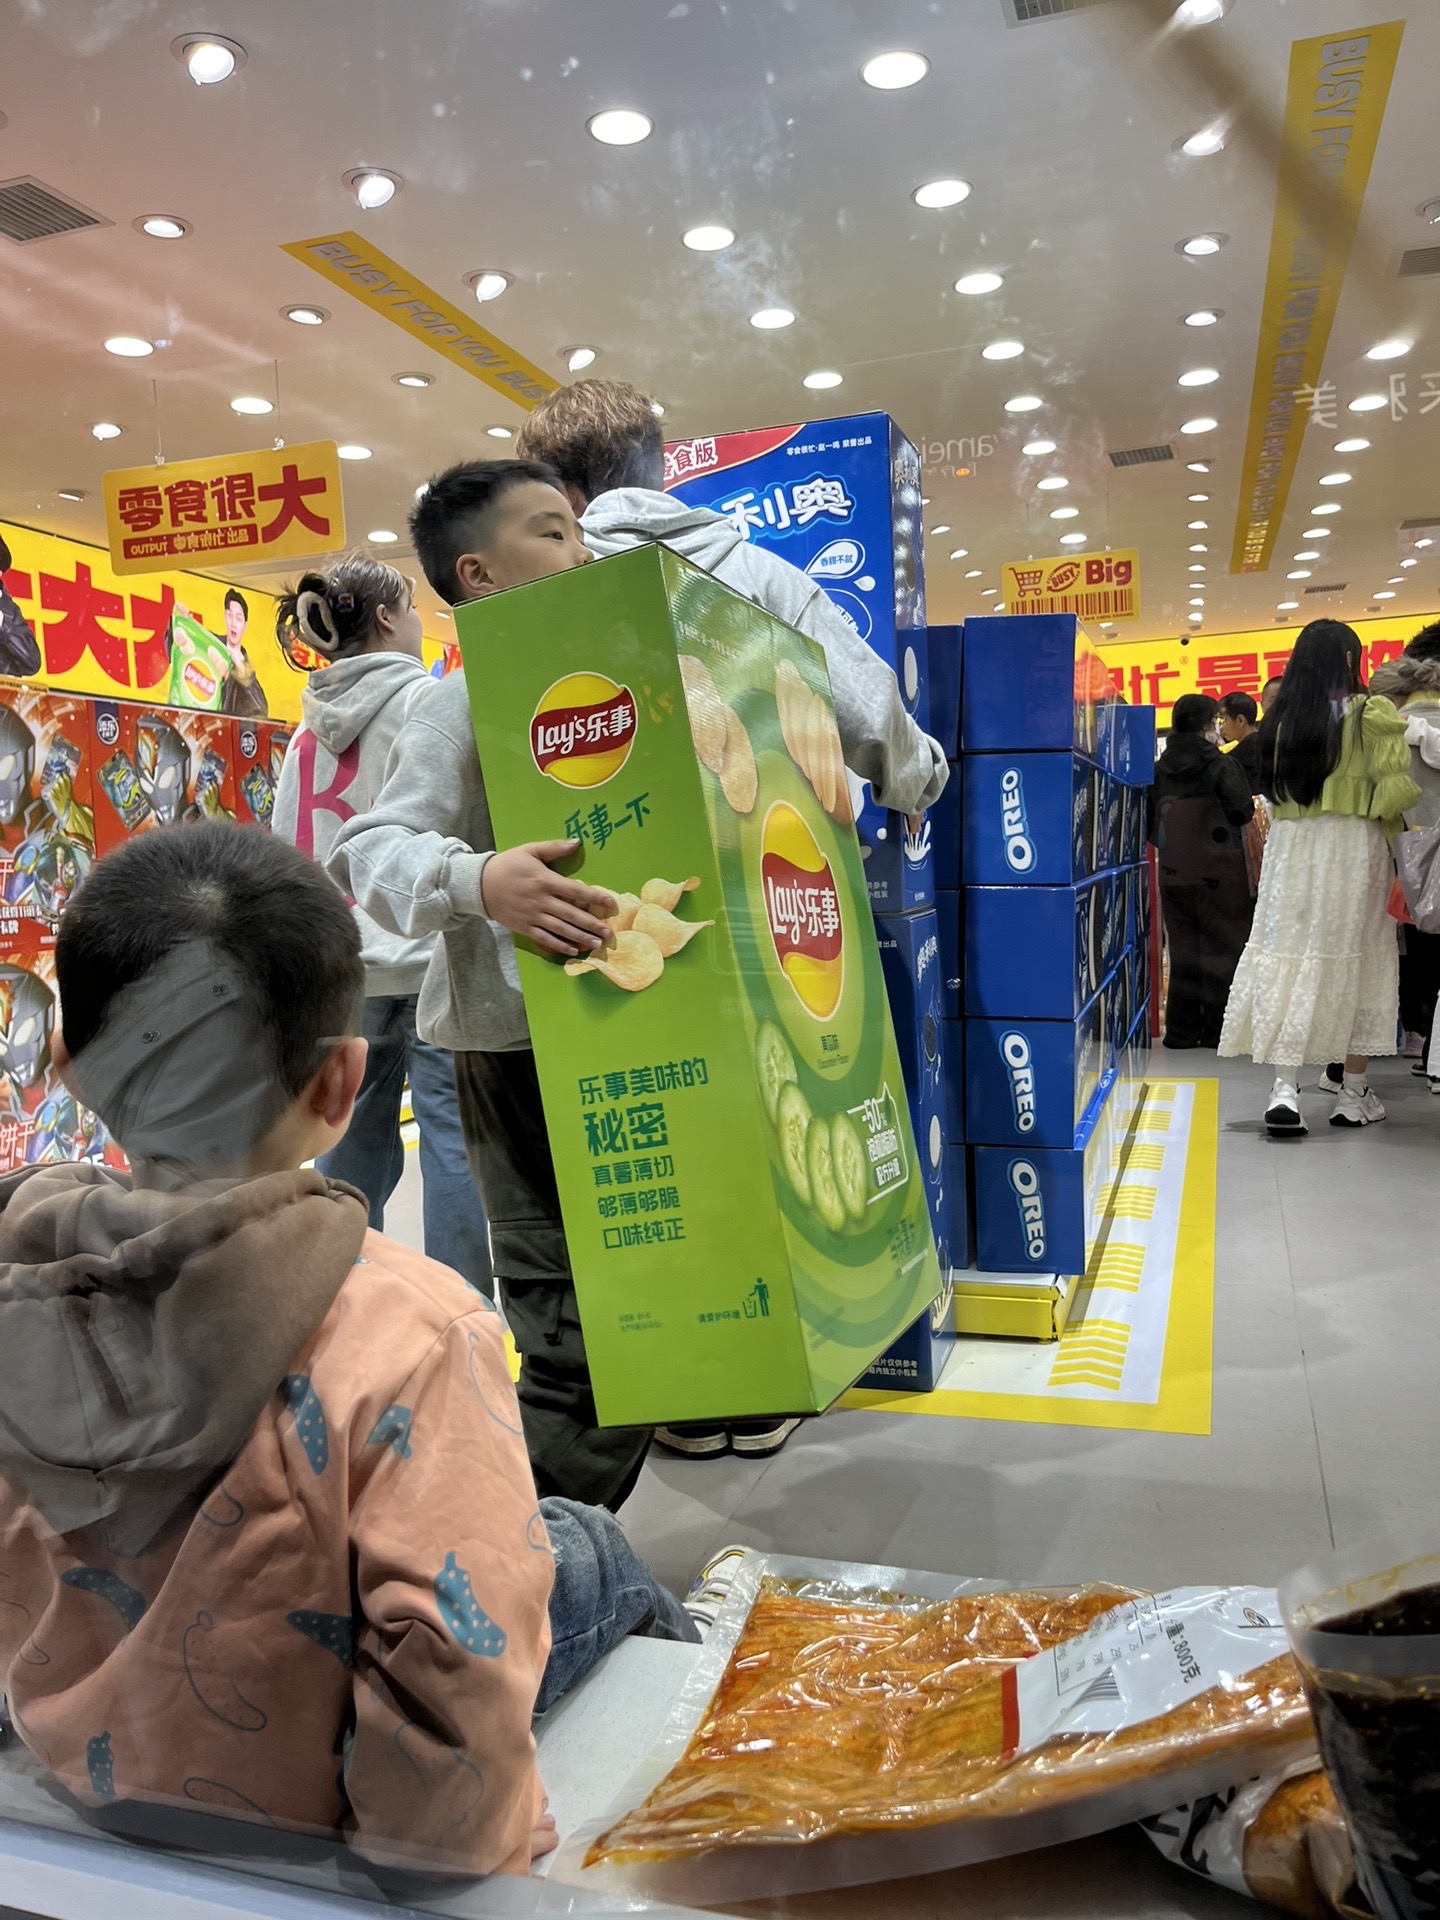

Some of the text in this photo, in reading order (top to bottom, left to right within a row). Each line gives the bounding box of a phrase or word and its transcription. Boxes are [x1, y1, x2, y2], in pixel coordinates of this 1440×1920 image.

[1313, 34, 1371, 118] BUSY
[306, 240, 551, 401] BUSY FOR YOU BUS
[117, 464, 331, 544] 零食很大
[130, 541, 168, 555] OUTPUT
[1050, 559, 1132, 588] BUSY Big
[537, 704, 633, 756] Lay's乐事
[564, 792, 650, 850] 乐事一下
[1003, 769, 1032, 870] OREO
[767, 876, 839, 944] Lay's乐事
[578, 1057, 709, 1106] 乐事美味的
[1004, 1035, 1034, 1132] OREO
[583, 1103, 669, 1157] 秘密
[592, 1155, 675, 1188] 真薯薄切
[598, 1186, 680, 1218] 够薄够脆
[1012, 1162, 1044, 1258] OREO
[603, 1218, 686, 1249] 口味纯正
